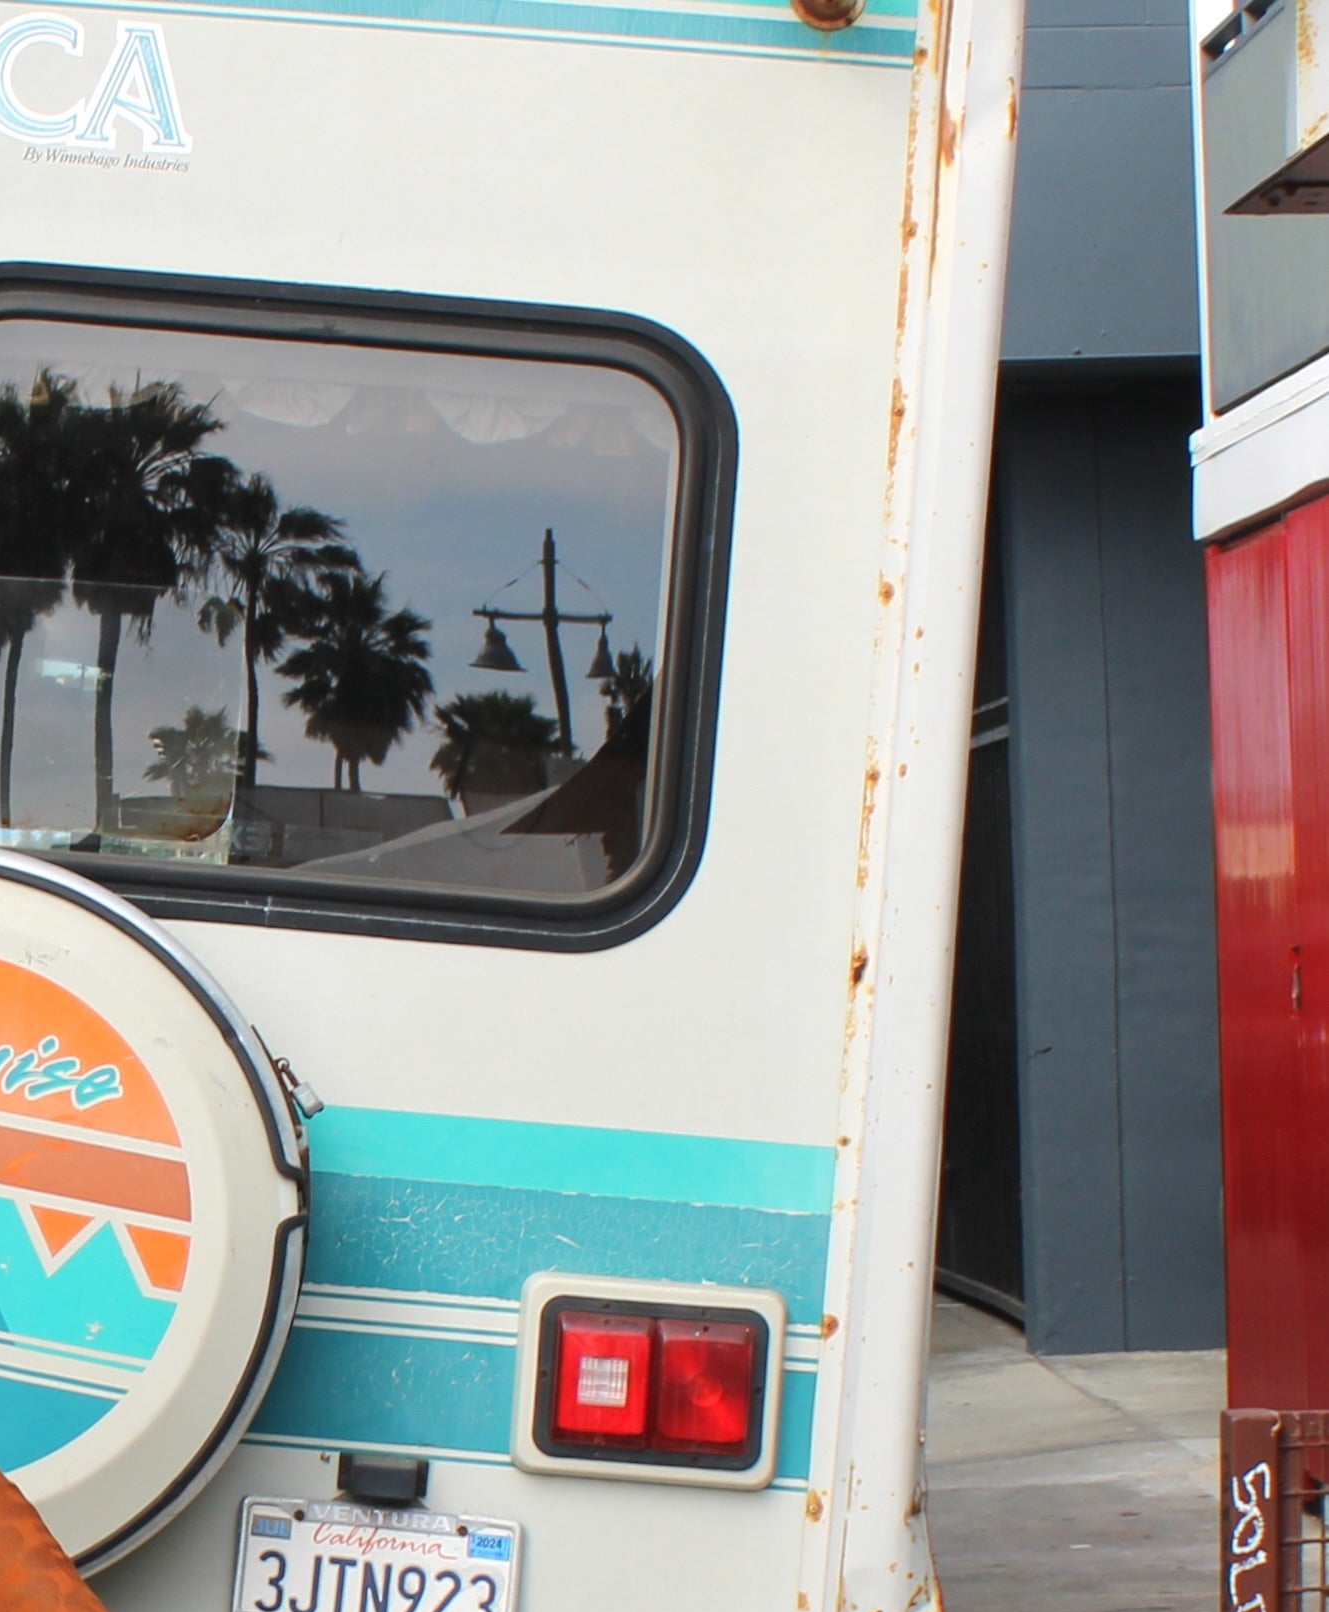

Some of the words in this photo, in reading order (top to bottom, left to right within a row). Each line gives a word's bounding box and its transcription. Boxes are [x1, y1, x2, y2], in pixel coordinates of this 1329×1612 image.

[22, 146, 42, 163] By
[46, 148, 119, 169] Winnebago
[123, 153, 191, 172] Industries
[253, 1518, 290, 1537] JUL
[314, 1504, 450, 1532] VENTURA
[313, 1521, 458, 1560] California
[476, 1536, 502, 1549] 2024
